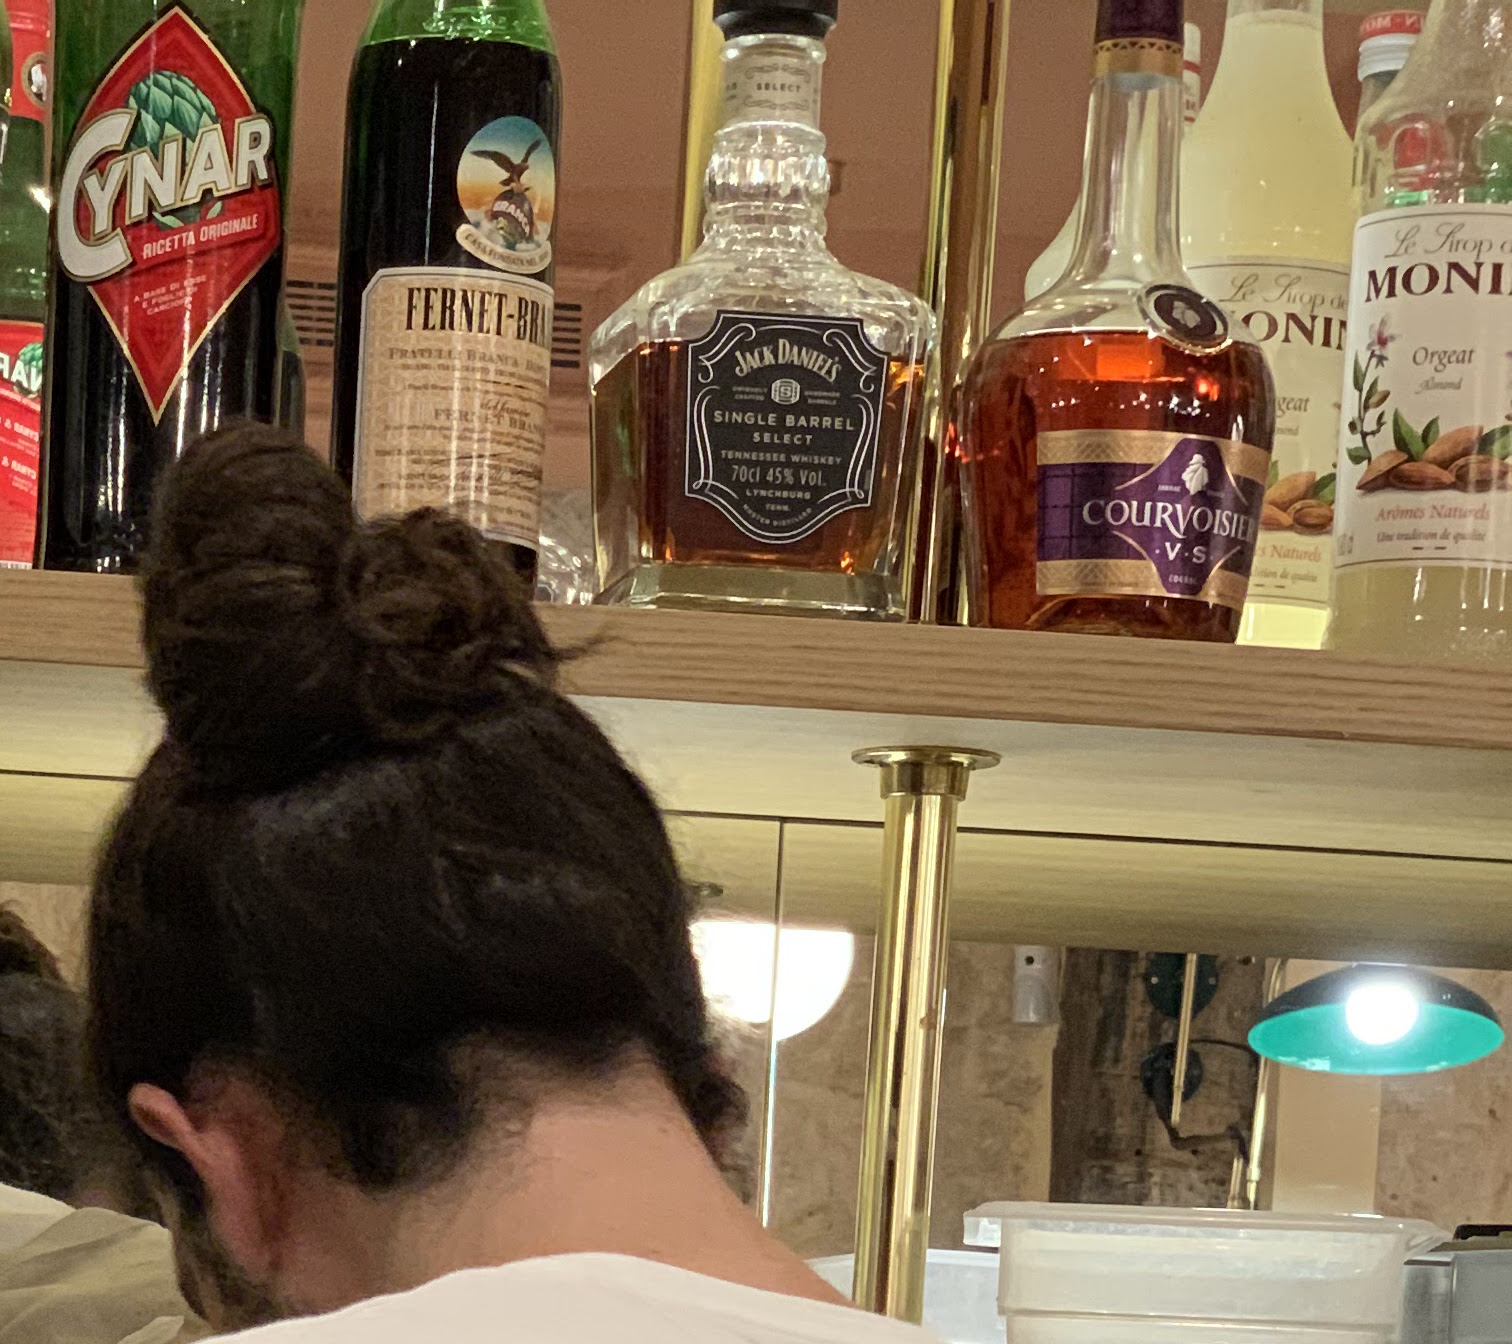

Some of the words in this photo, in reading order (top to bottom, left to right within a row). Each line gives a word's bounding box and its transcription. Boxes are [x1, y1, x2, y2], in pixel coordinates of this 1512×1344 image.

[756, 82, 801, 93] SELECT
[58, 108, 274, 282] CYNAR
[493, 200, 531, 237] BRANCA
[142, 228, 196, 260] RICETTA
[199, 213, 259, 242] ORIGINALE
[1385, 224, 1417, 258] Le
[1424, 222, 1494, 260] Sirop
[1218, 272, 1256, 304] Le
[1267, 273, 1327, 314] Sirop
[1365, 260, 1512, 303] MONI
[734, 345, 777, 377] JACK
[778, 338, 841, 383] DANIEL'S
[1412, 346, 1476, 373] Orgeat
[713, 410, 778, 426] SINGLE
[785, 414, 855, 431] BARREL
[1276, 396, 1310, 420] geat
[752, 431, 814, 446] SELECT
[721, 450, 787, 463] TENNESSEE
[791, 453, 843, 466] WHISKEY
[766, 466, 794, 485] 45%
[745, 487, 812, 500] LYNCHBURG
[1429, 503, 1492, 522] Naturels
